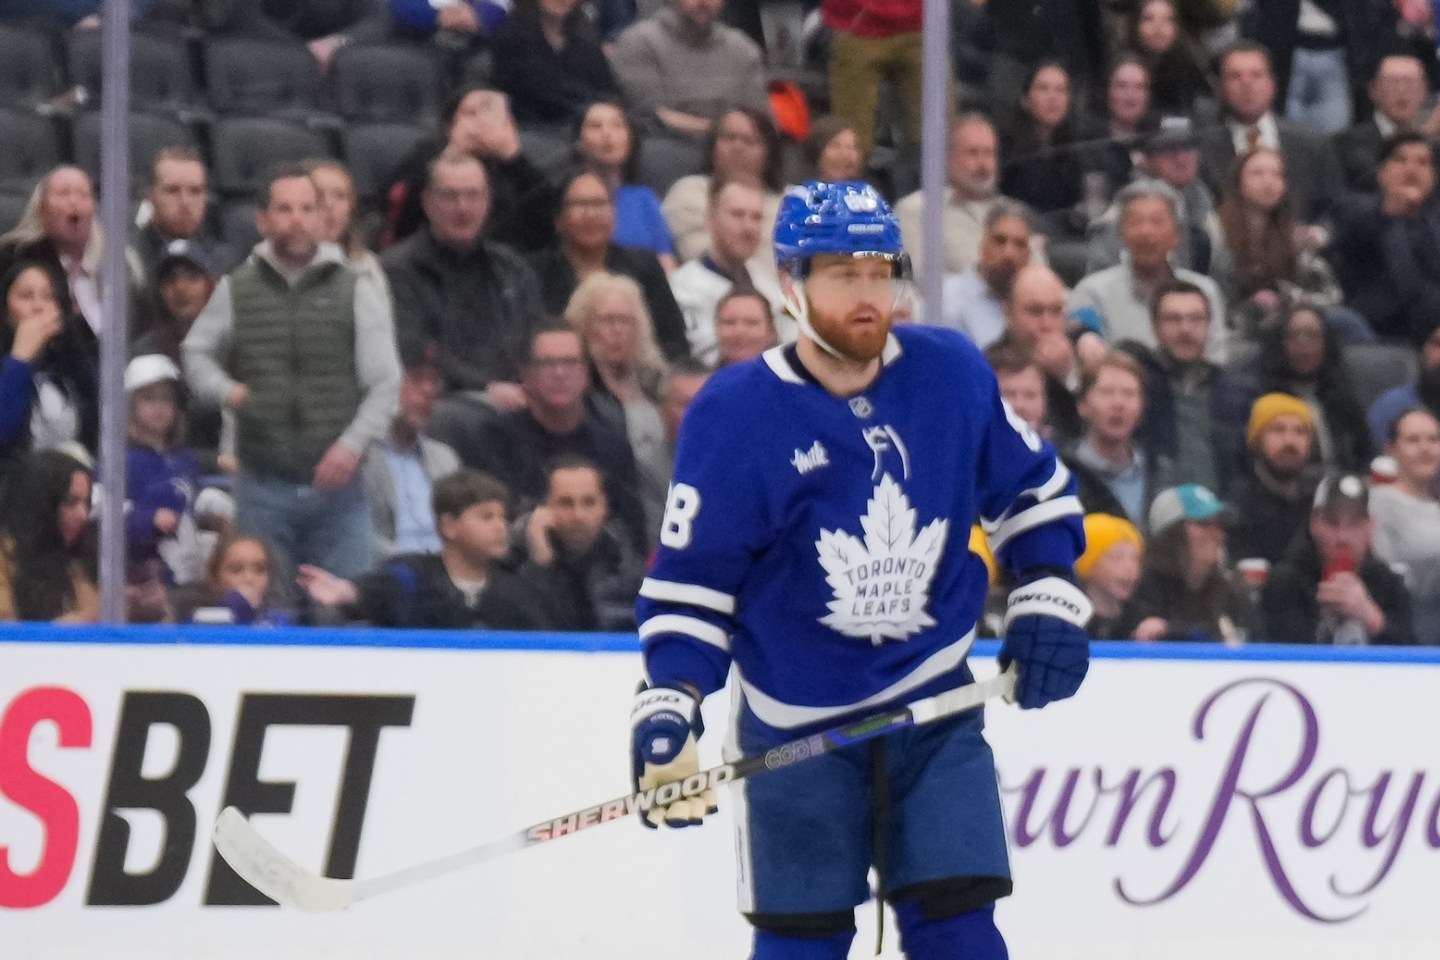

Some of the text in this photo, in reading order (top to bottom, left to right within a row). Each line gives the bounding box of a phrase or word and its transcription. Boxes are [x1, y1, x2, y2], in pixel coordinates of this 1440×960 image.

[660, 481, 701, 549] 8
[843, 557, 926, 586] TORONTO
[855, 579, 913, 598] MAPLE
[852, 597, 910, 616] LEAFS
[527, 763, 735, 844] SHERWOOD
